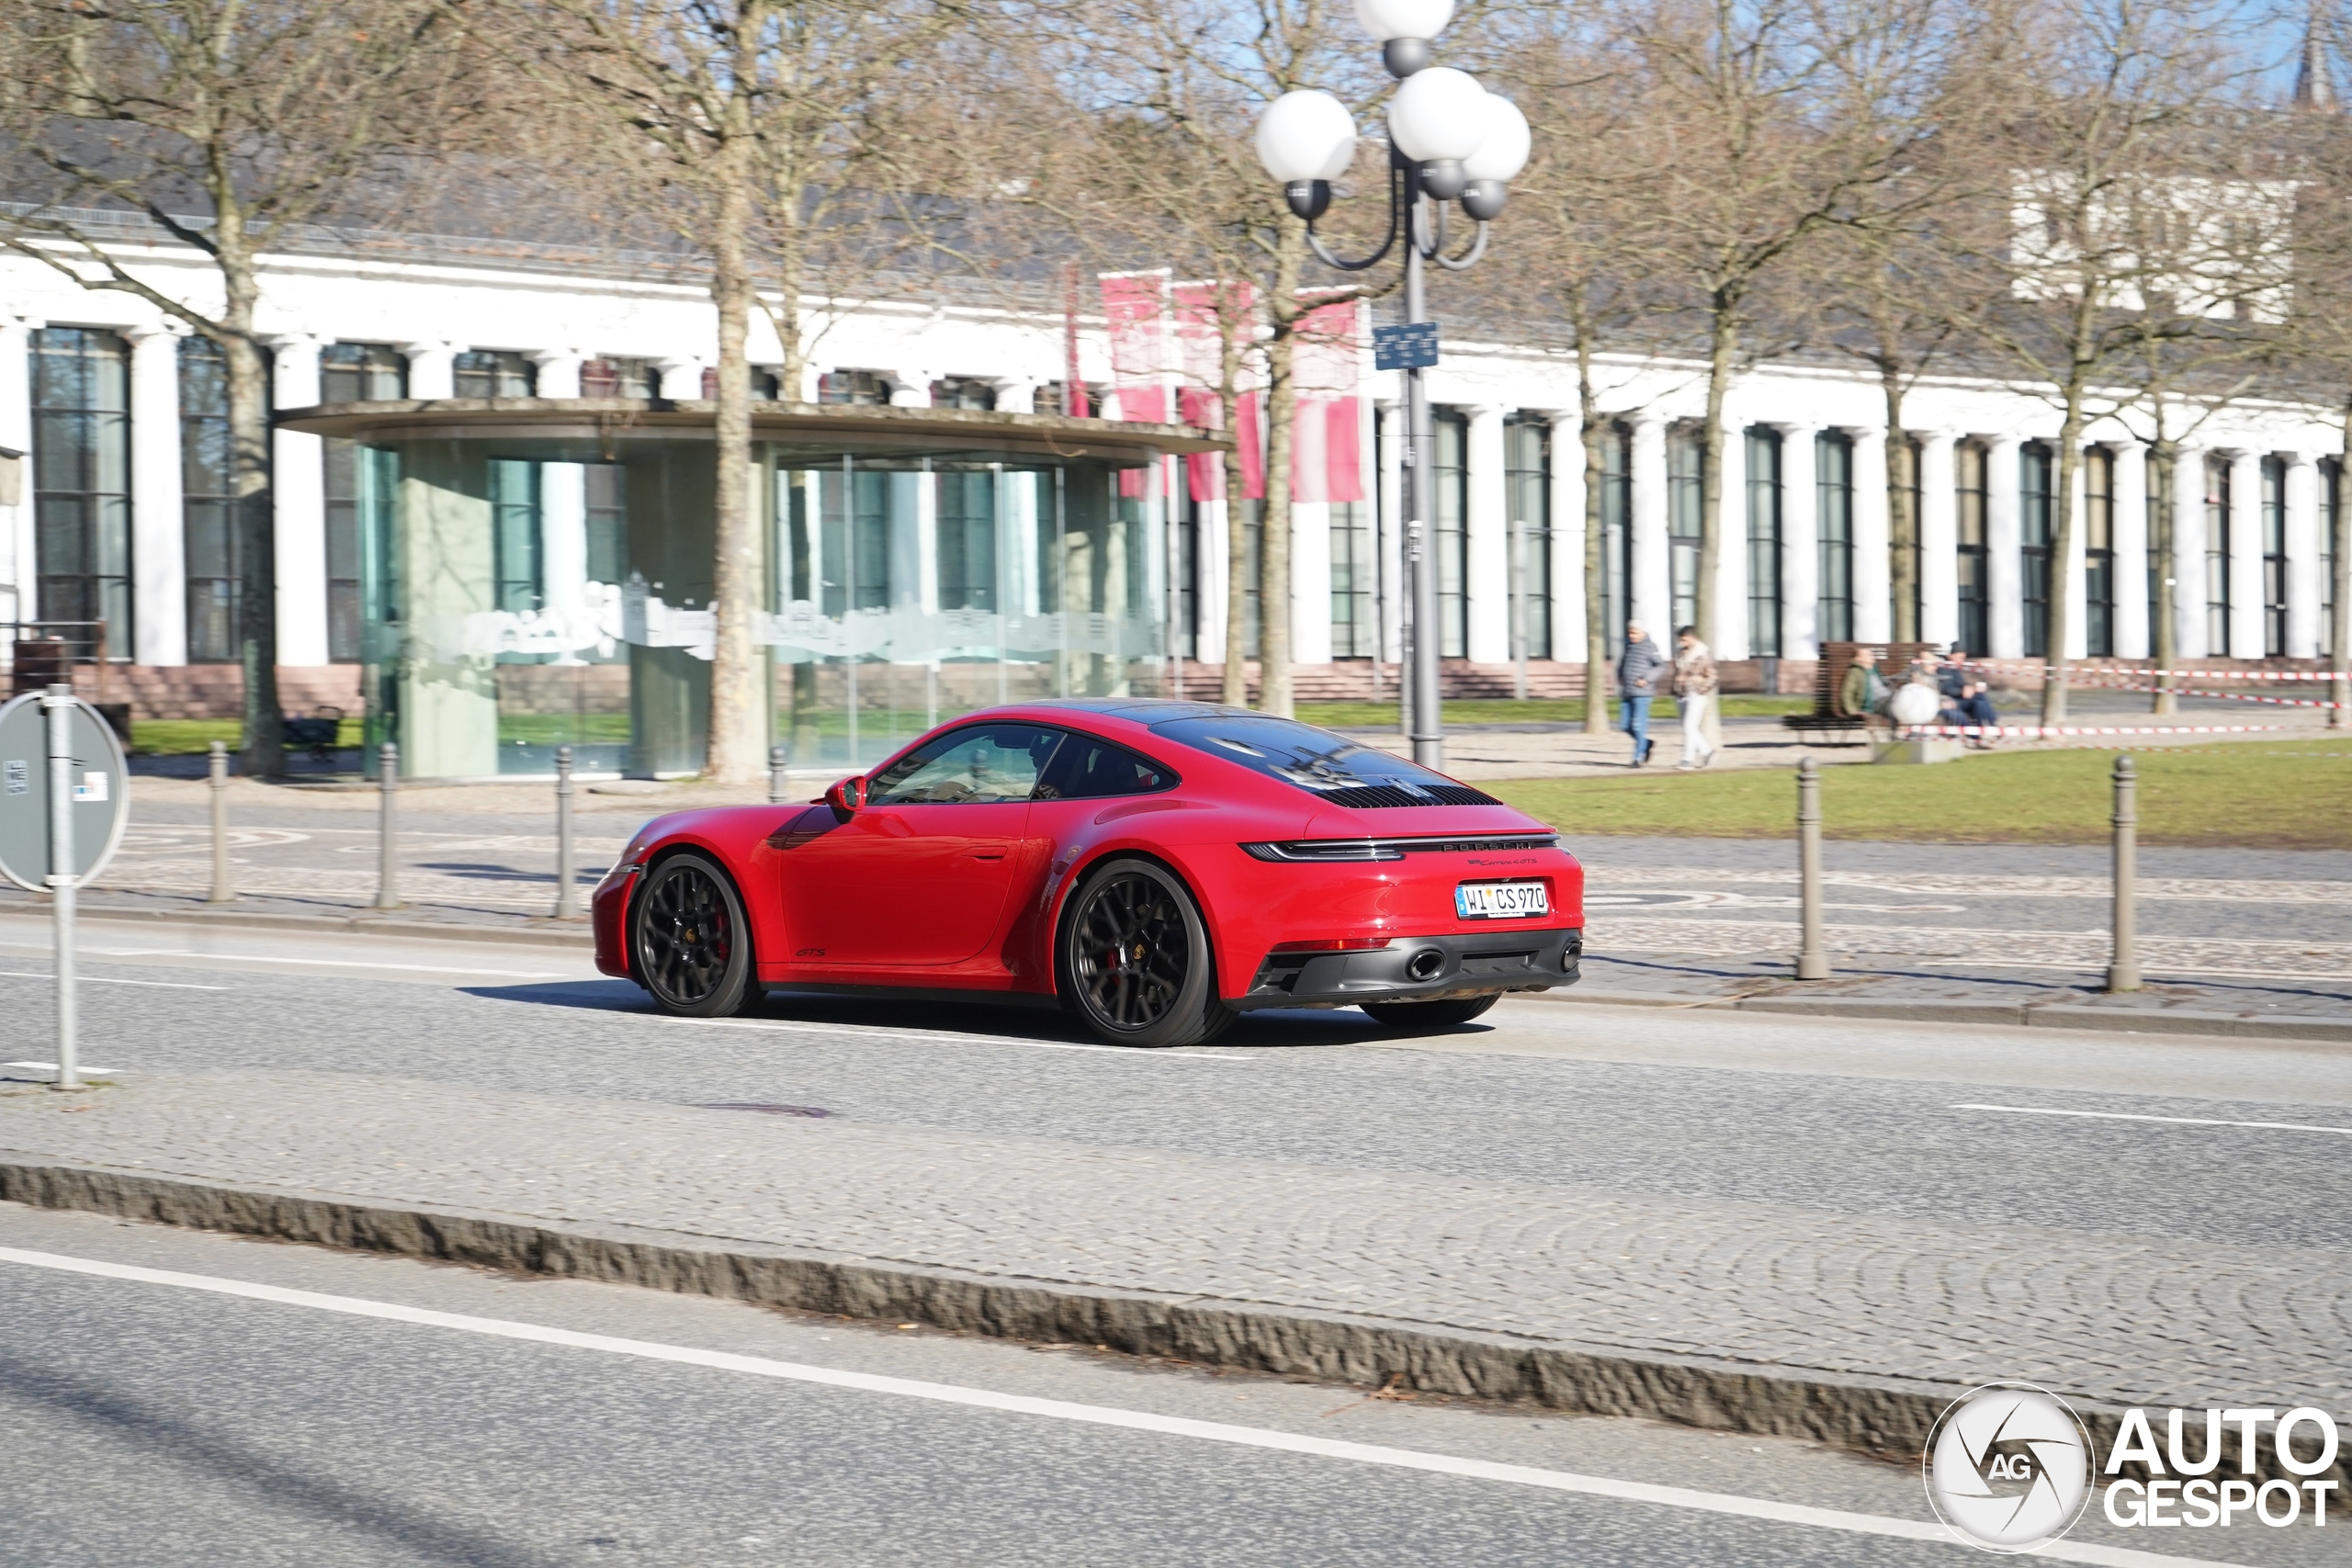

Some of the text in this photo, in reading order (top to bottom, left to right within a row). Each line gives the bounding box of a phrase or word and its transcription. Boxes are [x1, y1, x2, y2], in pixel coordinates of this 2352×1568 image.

[1443, 842, 1535, 852] PORSCHE
[1465, 887, 1544, 910] WI CS 970
[795, 948, 826, 956] GTS
